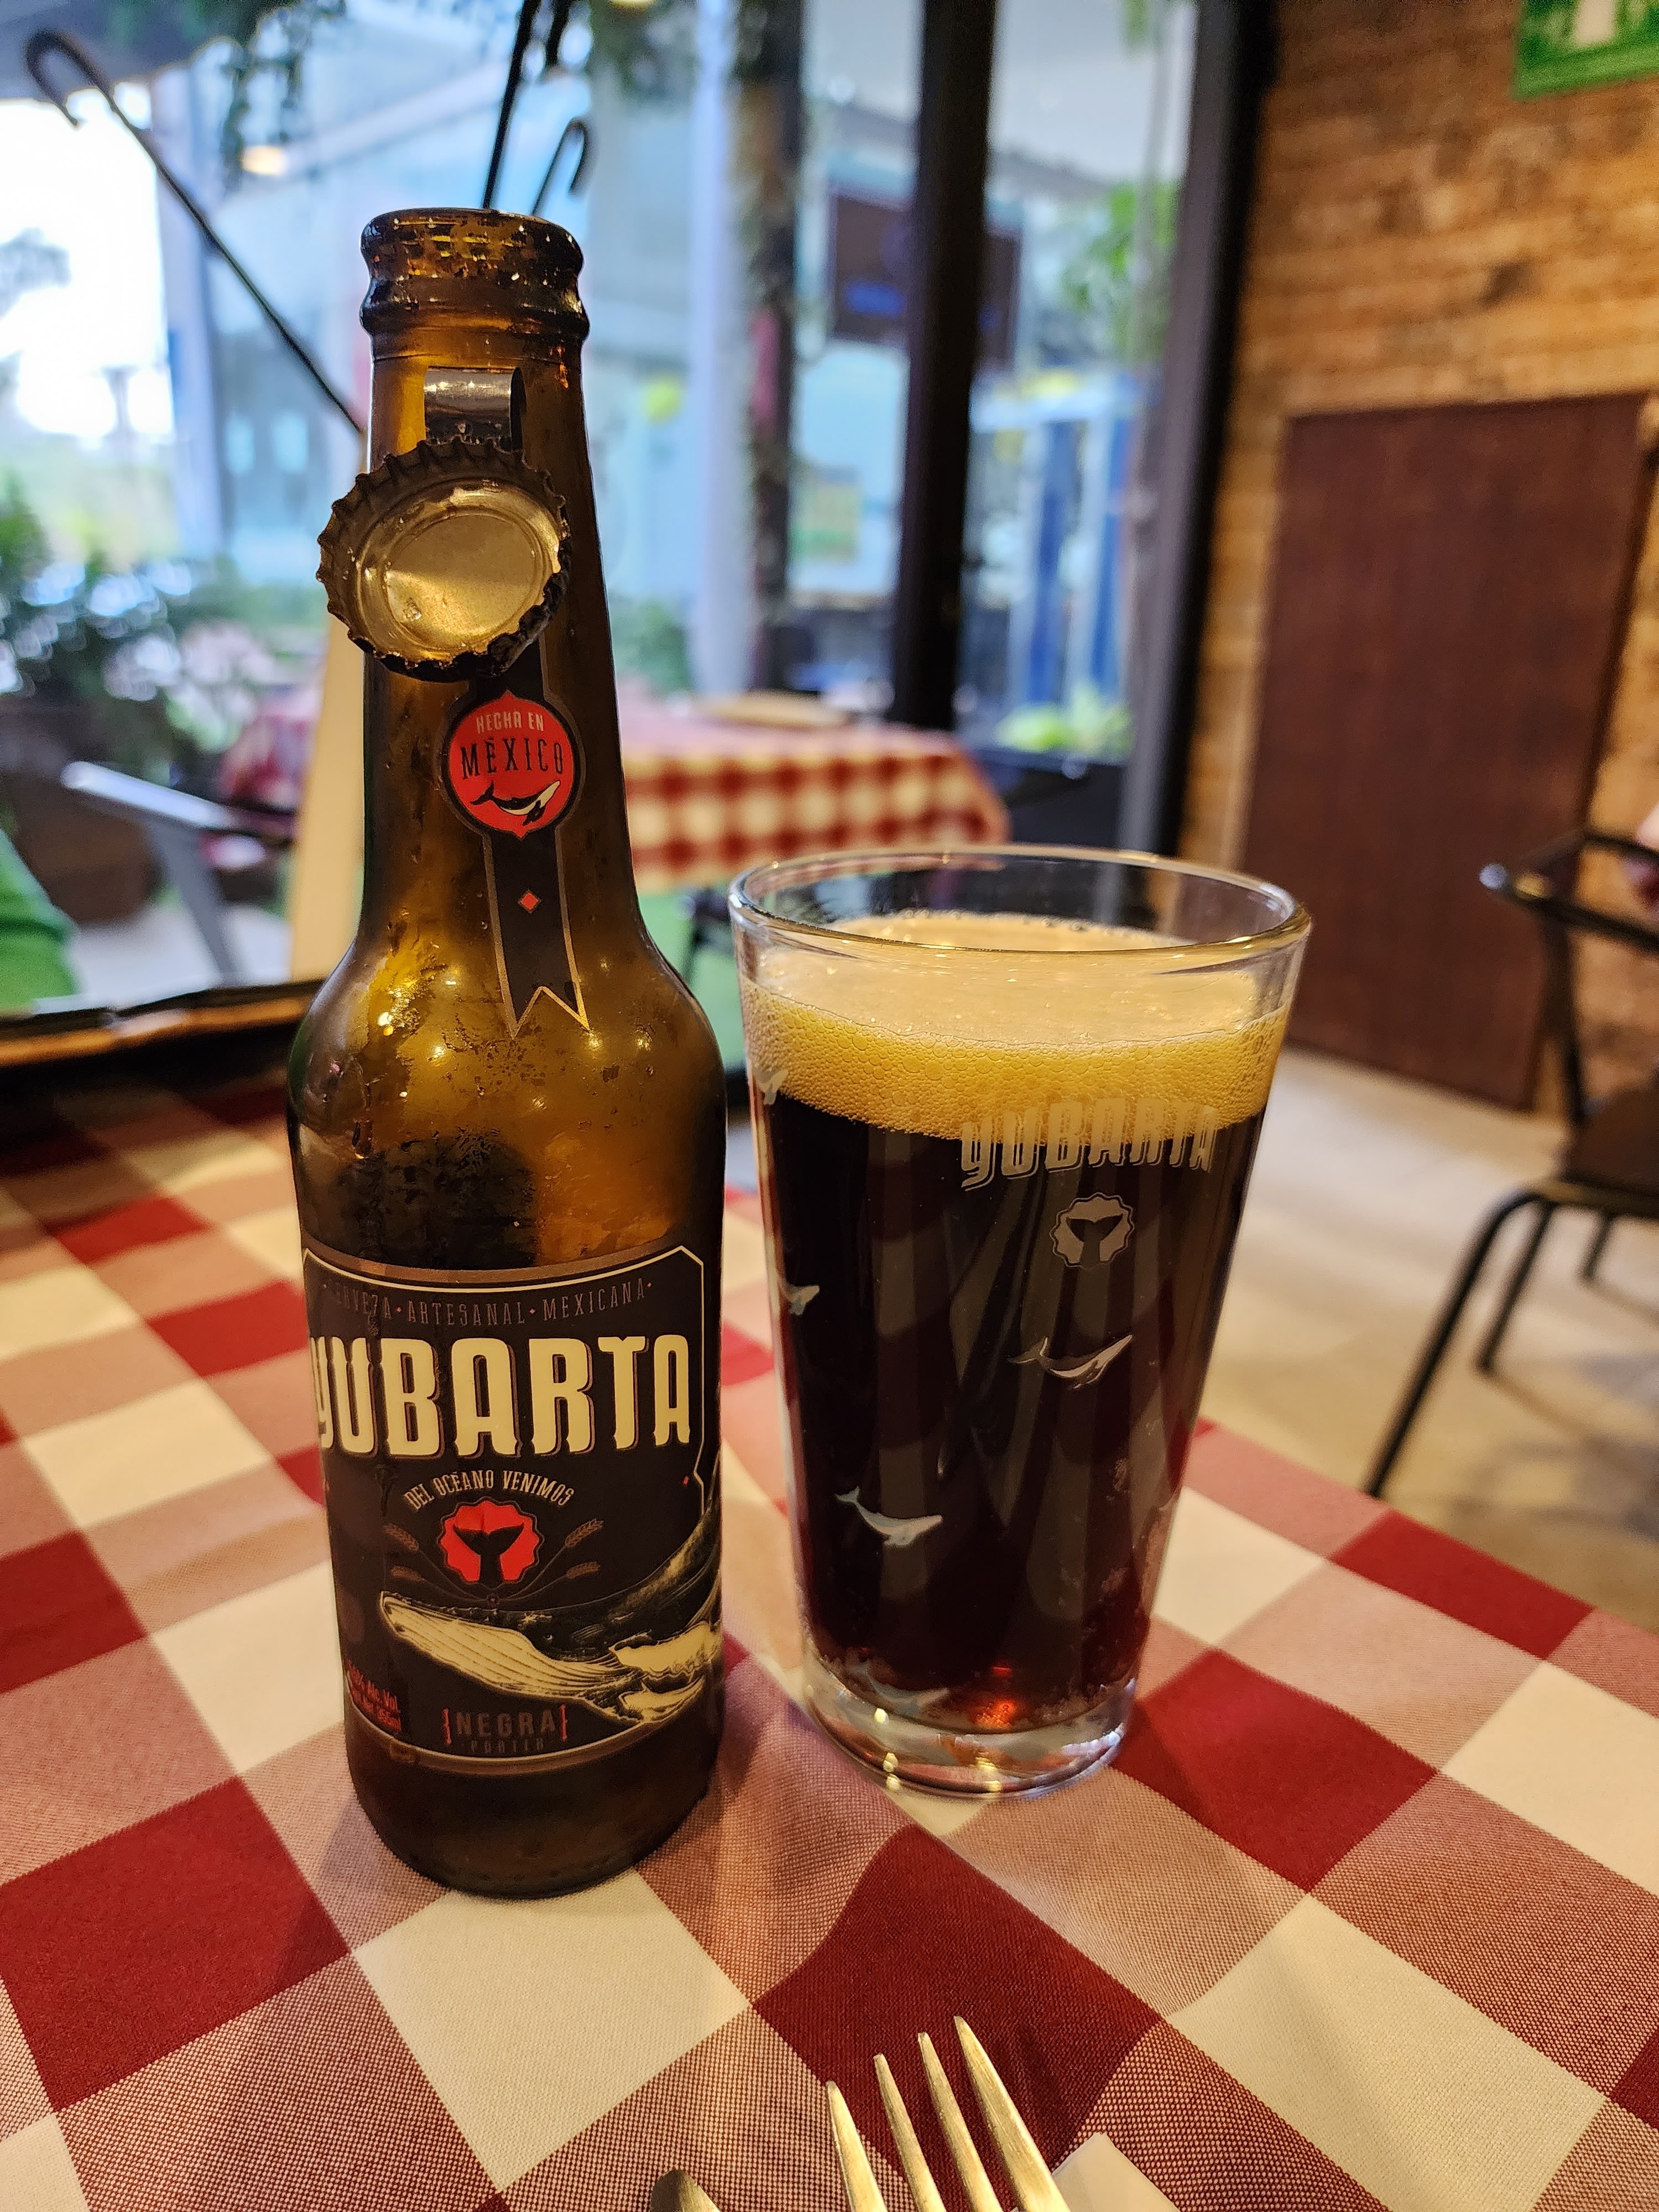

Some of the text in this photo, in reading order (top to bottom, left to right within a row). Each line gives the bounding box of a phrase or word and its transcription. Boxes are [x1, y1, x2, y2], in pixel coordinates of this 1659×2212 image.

[476, 709, 544, 734] HECHA EN
[460, 736, 564, 780] MÉXICO
[330, 1277, 645, 1327] ERVEZA ARTESANAL MEXICANA
[404, 1470, 574, 1511] DEL OCÉANO VENIMOS
